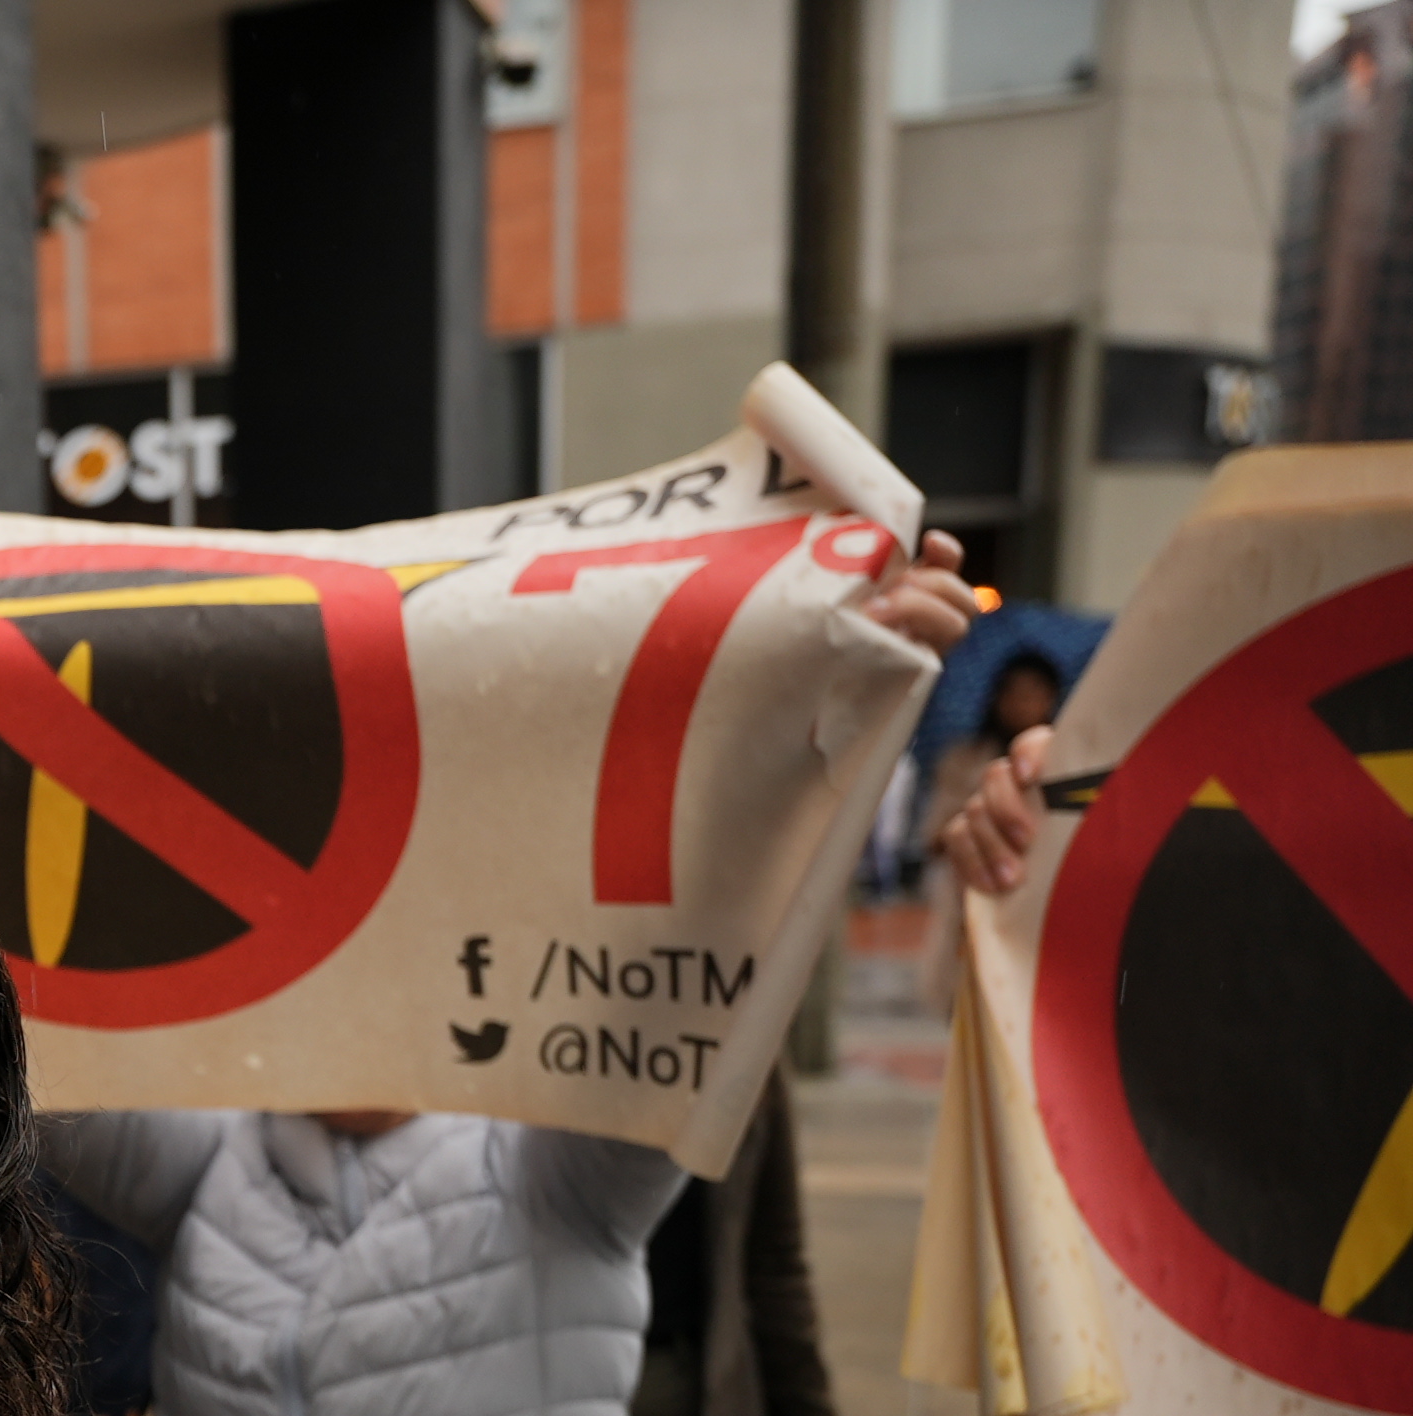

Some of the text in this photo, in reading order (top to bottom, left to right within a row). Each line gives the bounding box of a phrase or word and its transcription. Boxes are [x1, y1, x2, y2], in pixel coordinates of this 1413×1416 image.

[37, 414, 236, 508] OST
[489, 464, 727, 544] POR
[531, 938, 754, 1009] /NoTM
[540, 1022, 719, 1092] @NoT
